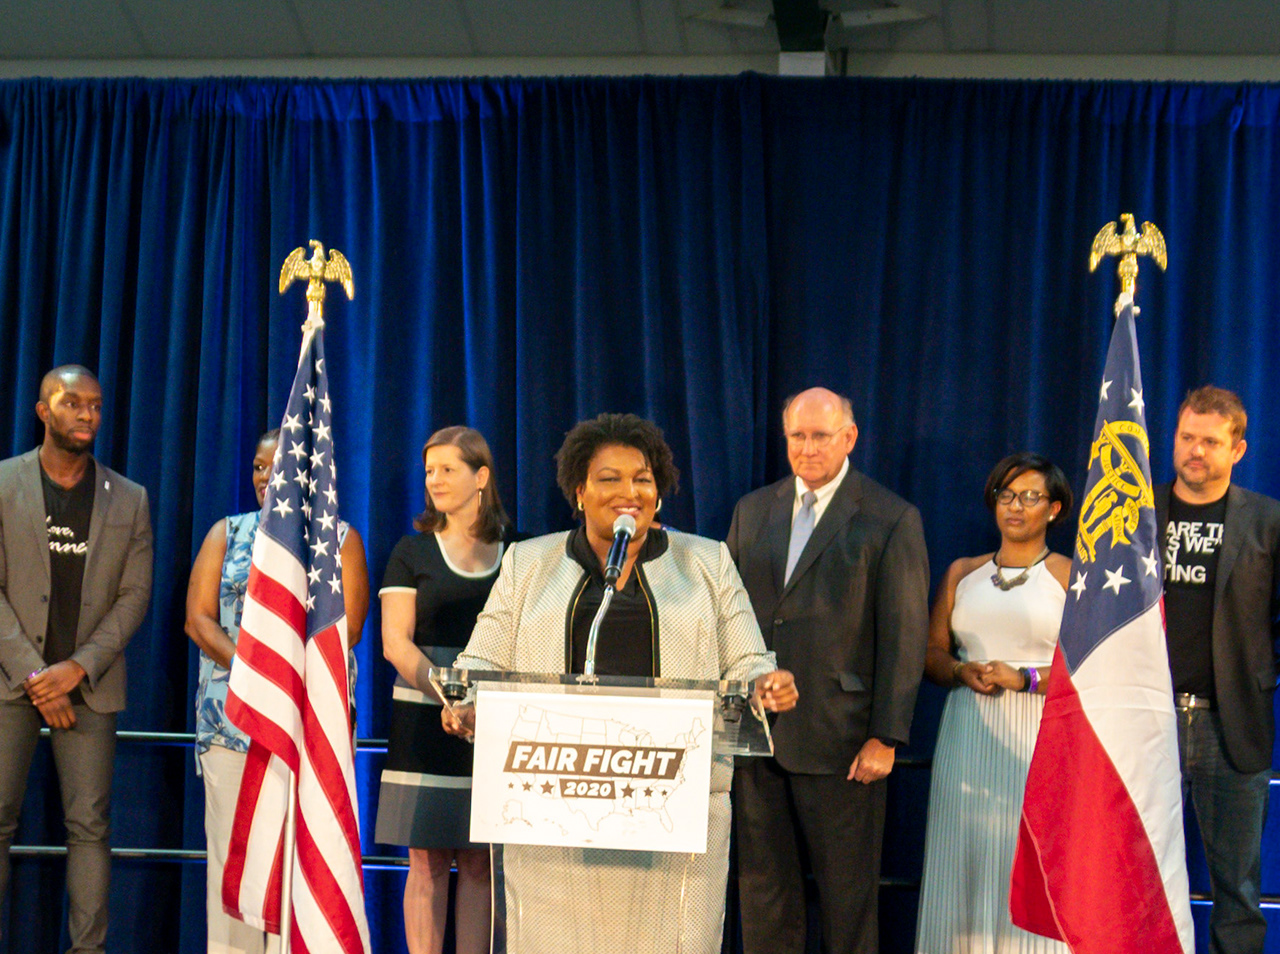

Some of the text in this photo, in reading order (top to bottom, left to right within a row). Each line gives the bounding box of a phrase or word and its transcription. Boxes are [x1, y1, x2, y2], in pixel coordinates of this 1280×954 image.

[1166, 520, 1203, 538] ARE
[511, 745, 677, 777] FAIR FIGHT
[563, 782, 612, 798] 2020
